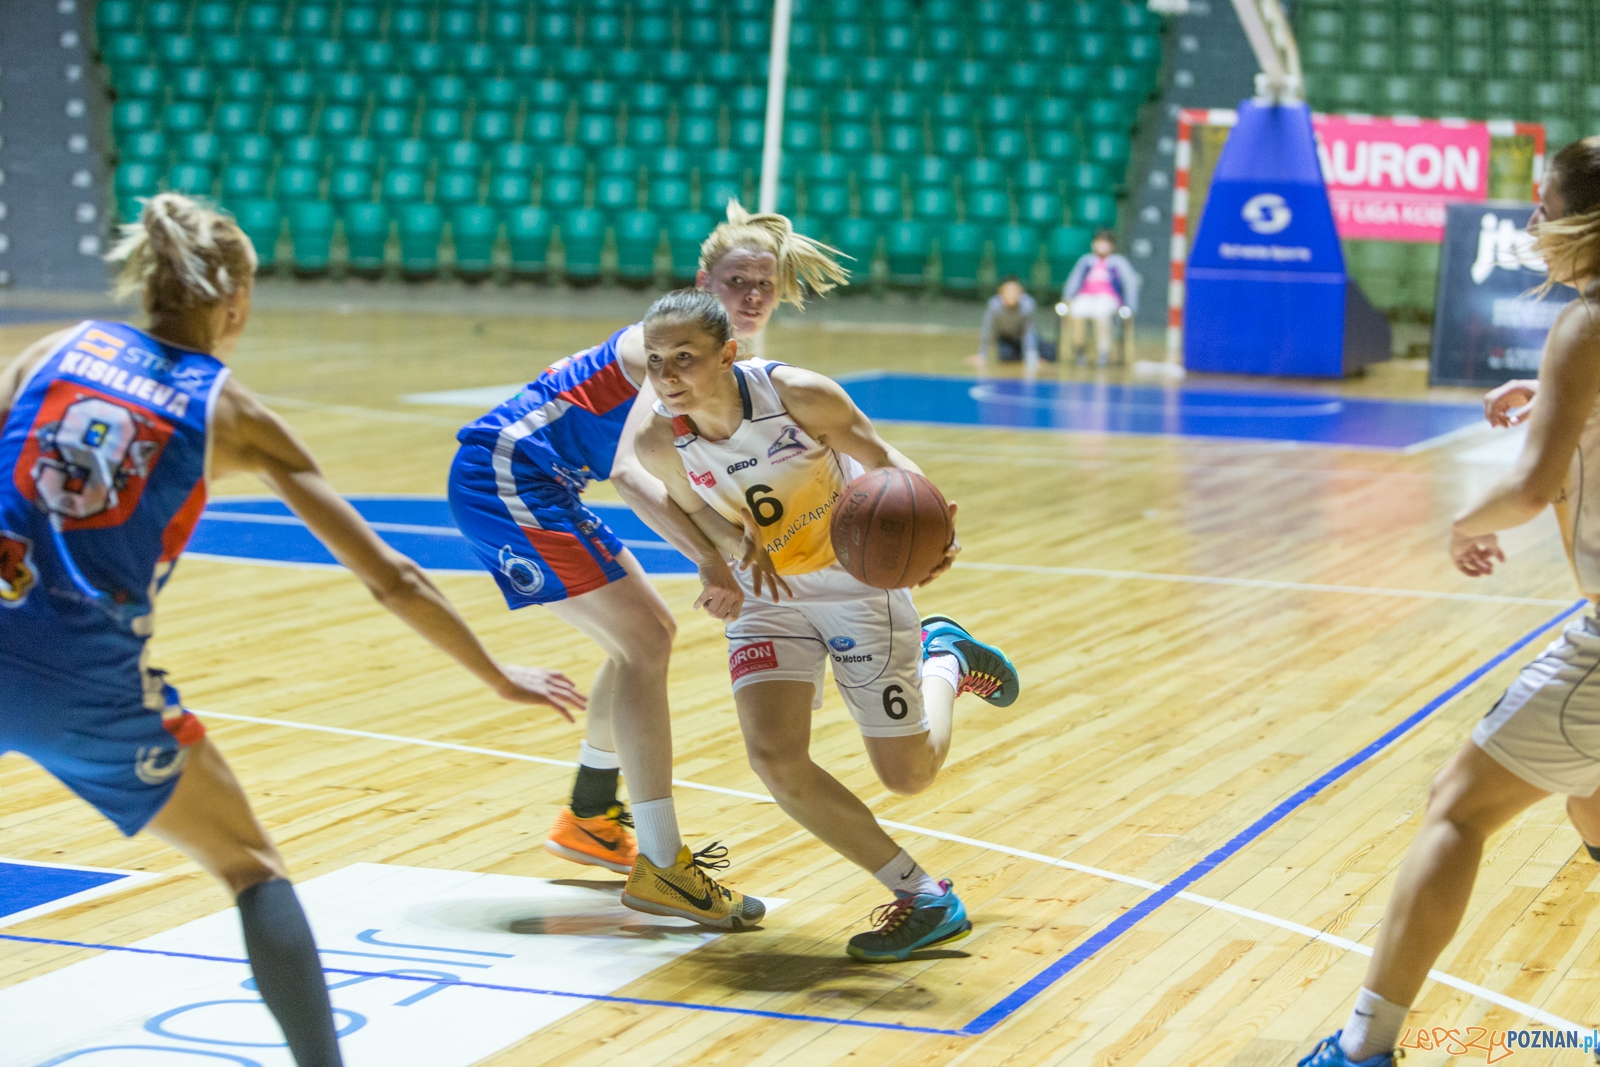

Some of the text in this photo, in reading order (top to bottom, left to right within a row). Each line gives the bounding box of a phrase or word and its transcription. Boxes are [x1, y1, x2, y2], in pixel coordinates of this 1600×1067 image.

[57, 350, 191, 419] KISILIEVA
[726, 457, 758, 475] GEDO
[746, 484, 783, 527] 6
[842, 654, 873, 664] Motors
[883, 685, 908, 720] 6
